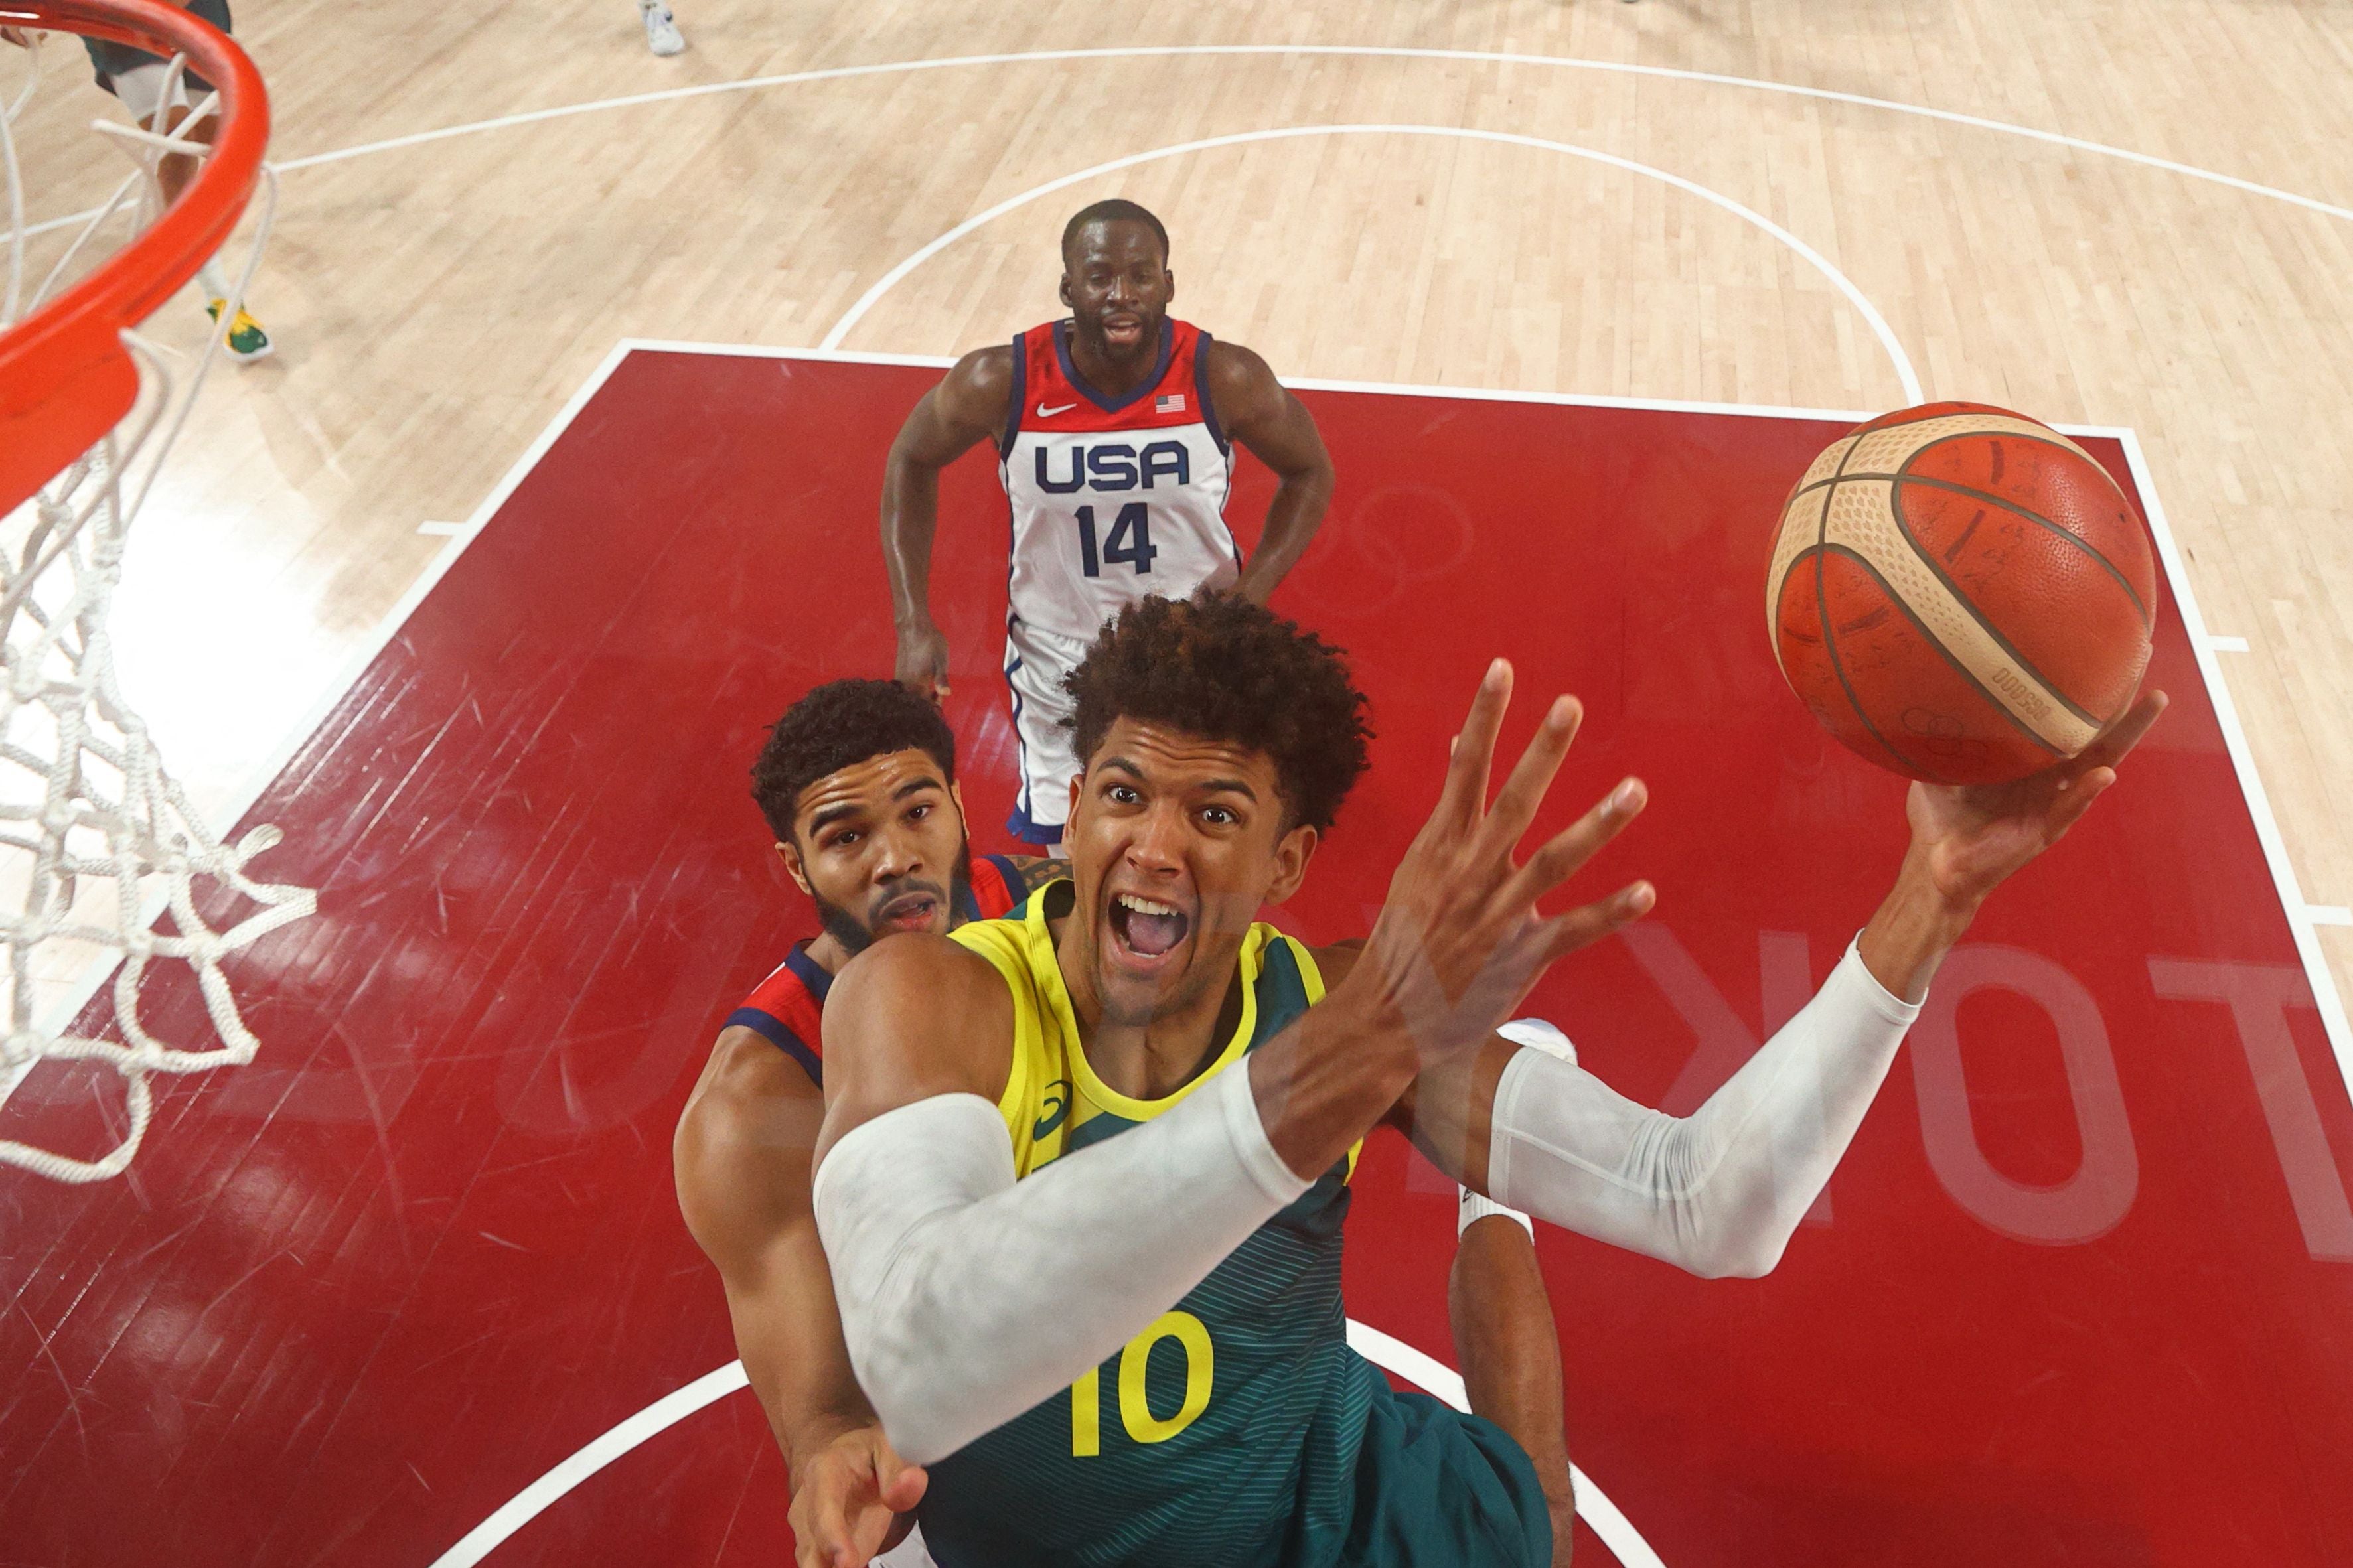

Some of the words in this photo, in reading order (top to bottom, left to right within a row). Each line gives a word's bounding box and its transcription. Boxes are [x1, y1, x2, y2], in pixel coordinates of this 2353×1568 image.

[1035, 440, 1190, 494] USA
[1074, 502, 1158, 577] 14
[1071, 1310, 1215, 1457] 10
